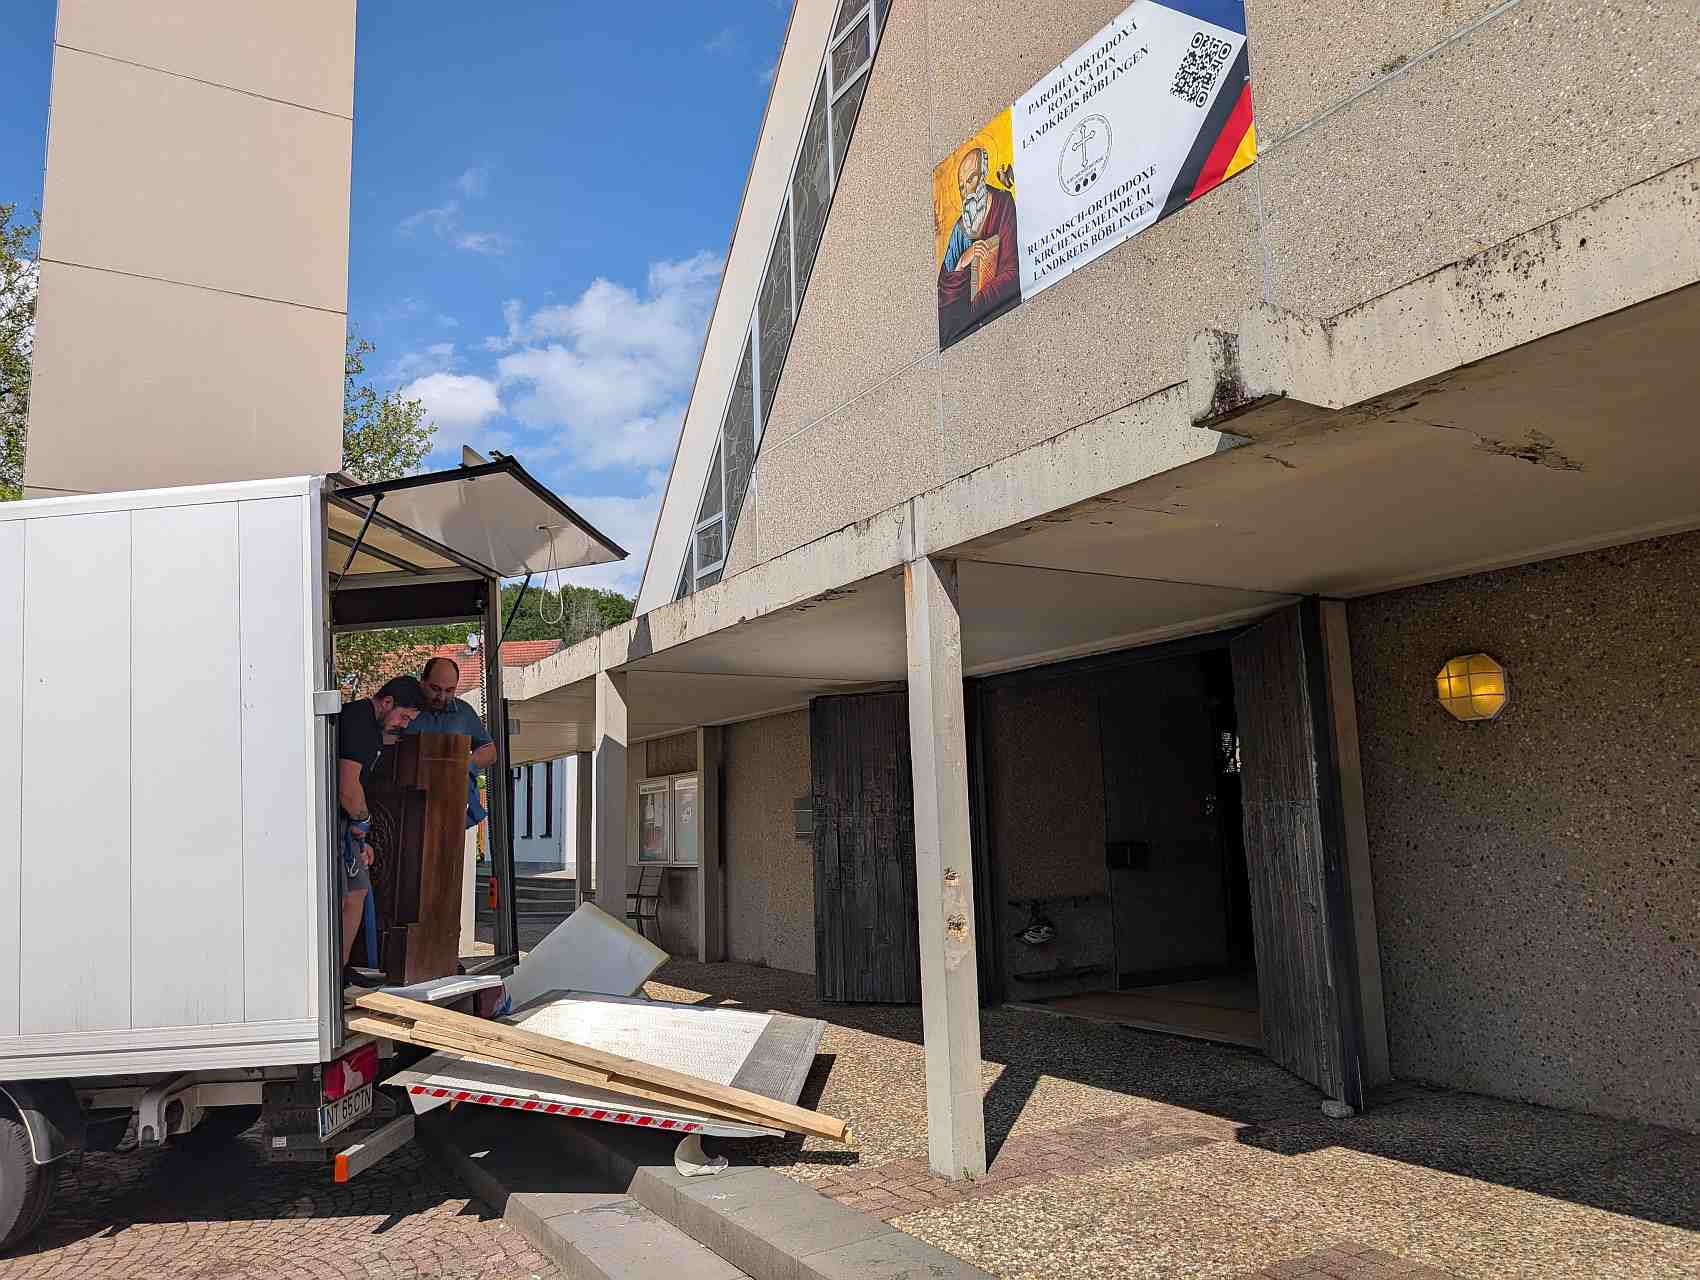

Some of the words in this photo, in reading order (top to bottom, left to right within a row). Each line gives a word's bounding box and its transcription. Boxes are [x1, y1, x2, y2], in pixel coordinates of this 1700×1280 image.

[1096, 55, 1117, 80] DIN
[1027, 73, 1073, 115] PAROHIA
[1022, 99, 1080, 150] LANDKREIS
[1033, 239, 1089, 281] LANDKREIS
[1091, 200, 1155, 245] BÖBLINGEN
[1034, 195, 1133, 266] KIRCHENGEMEINDE
[1136, 183, 1152, 201] IM
[326, 1104, 338, 1130] NT
